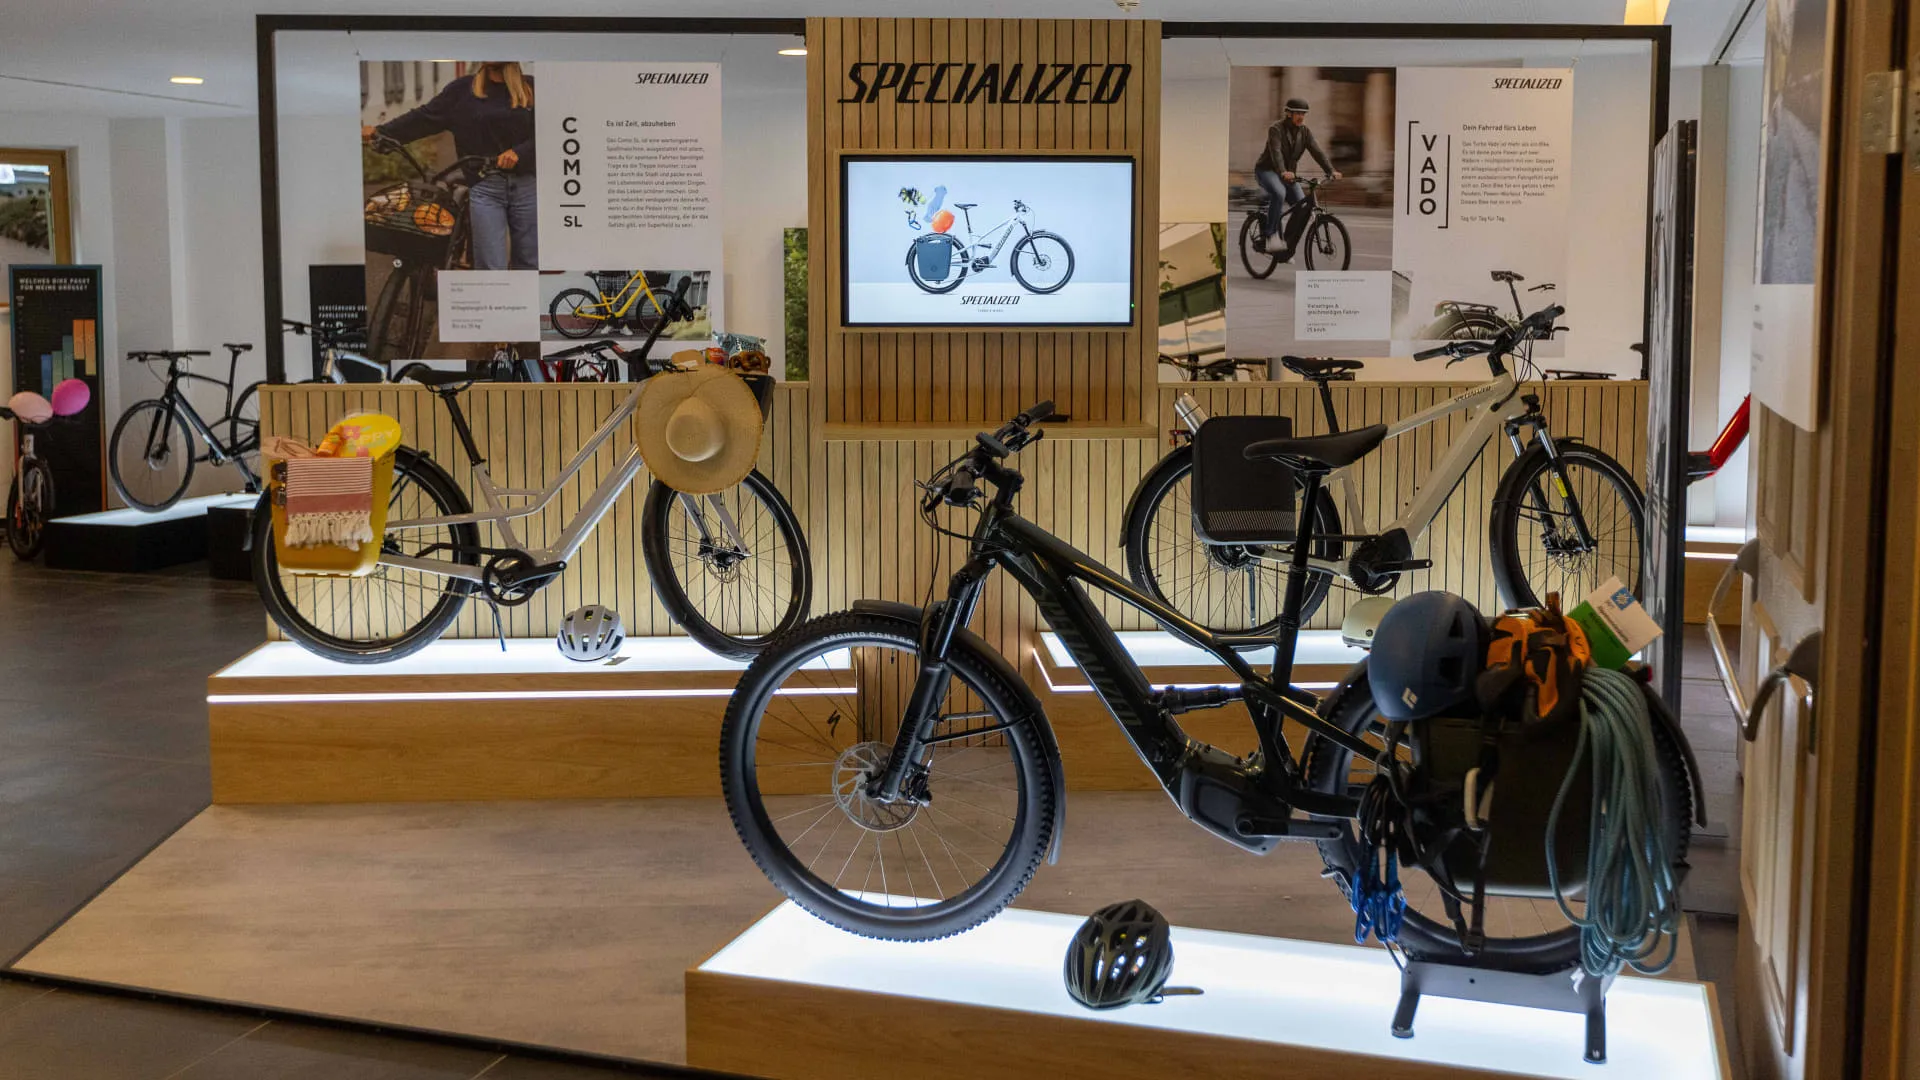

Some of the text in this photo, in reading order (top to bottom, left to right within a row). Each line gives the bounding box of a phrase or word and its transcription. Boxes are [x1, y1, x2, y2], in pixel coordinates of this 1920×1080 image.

[635, 73, 709, 84] SPECIALIZED
[837, 62, 1132, 104] SPECIALIZED
[1491, 78, 1562, 90] SPECIALIZED
[562, 117, 581, 196] COMO
[1419, 135, 1437, 215] VADO
[564, 216, 583, 228] SL
[960, 296, 1020, 305] SPECIALIZED
[823, 631, 866, 641] GROUND
